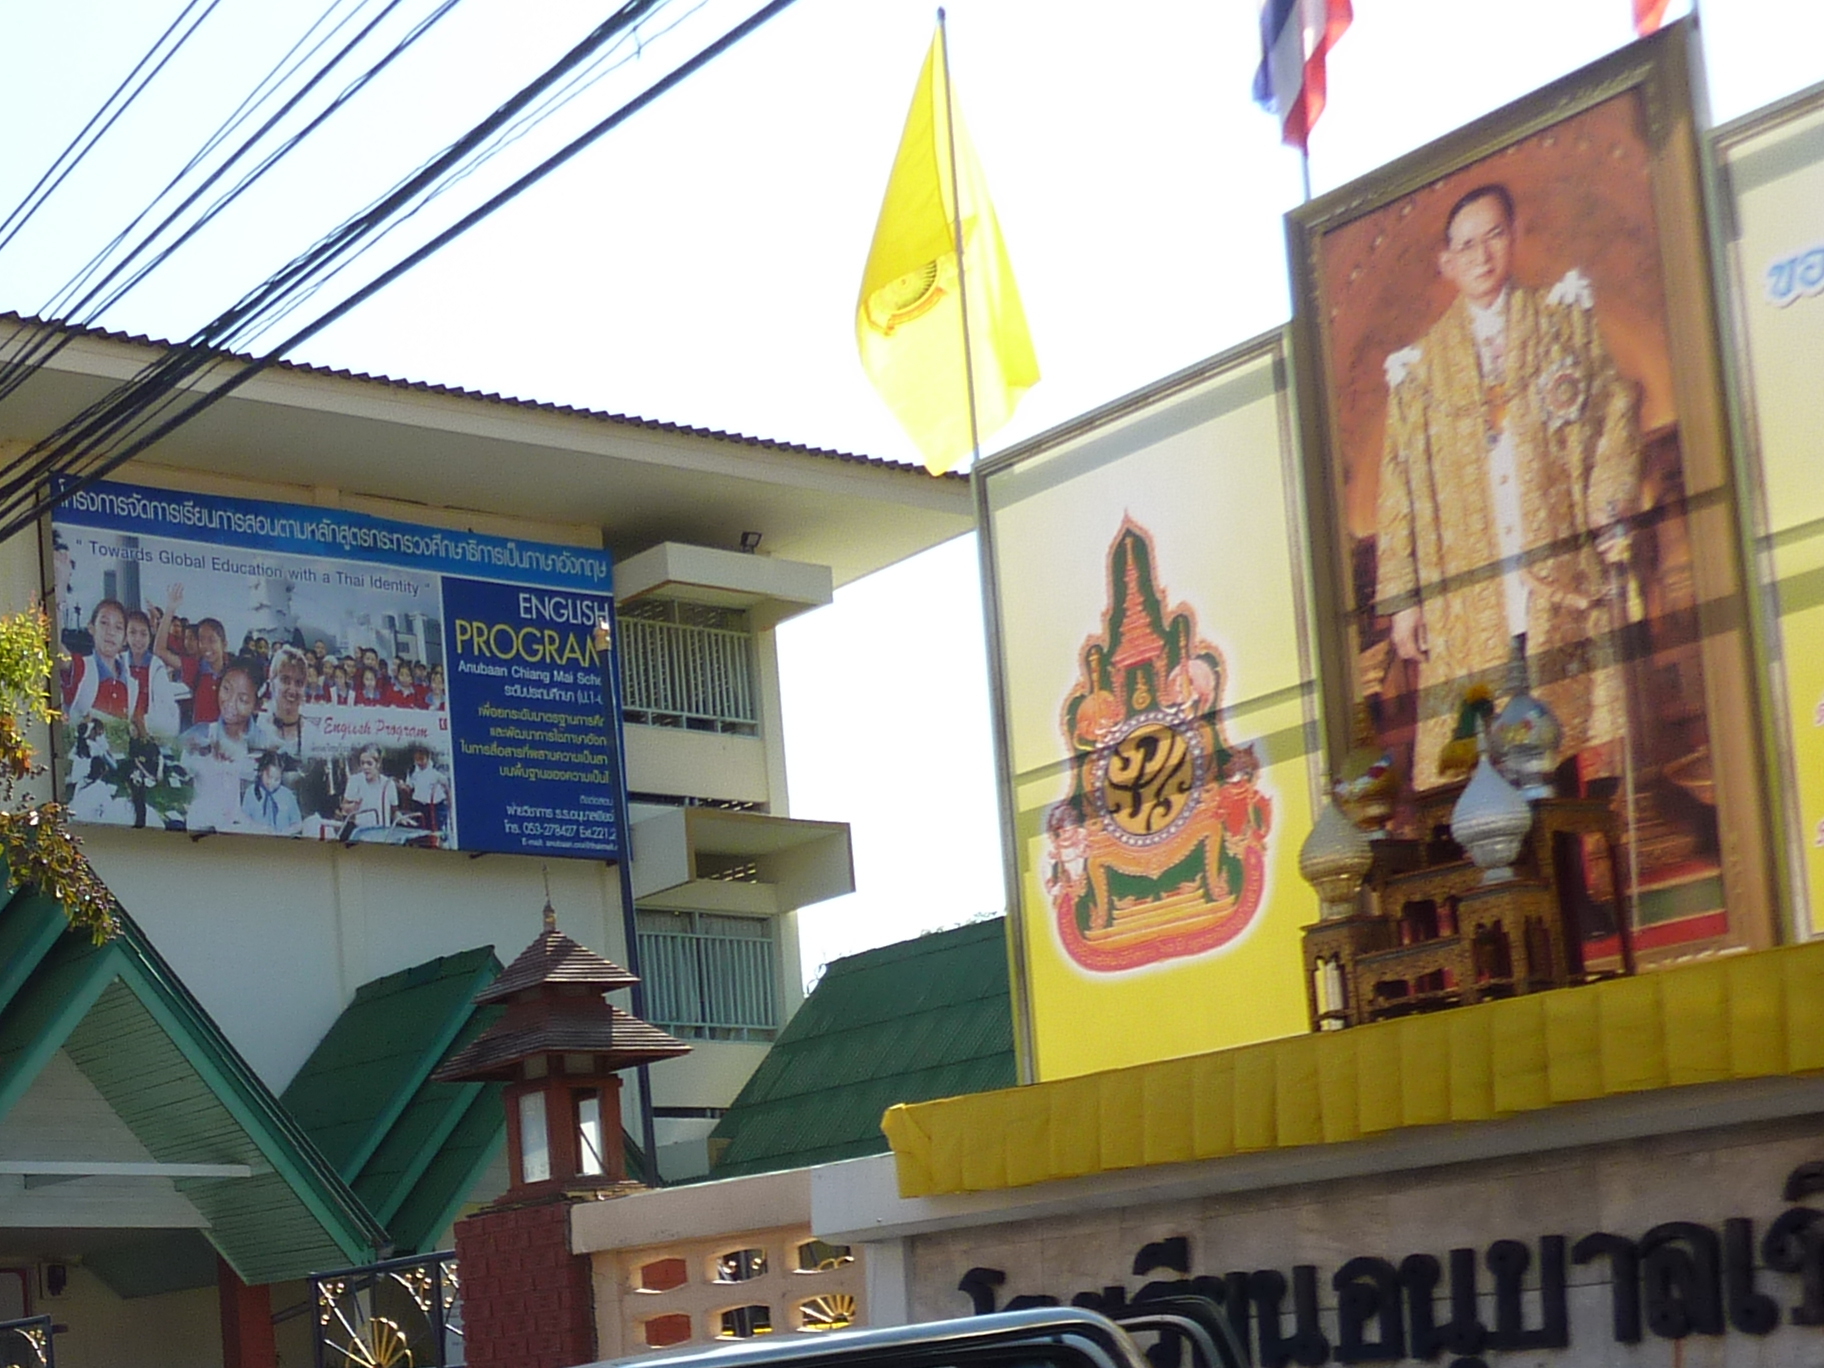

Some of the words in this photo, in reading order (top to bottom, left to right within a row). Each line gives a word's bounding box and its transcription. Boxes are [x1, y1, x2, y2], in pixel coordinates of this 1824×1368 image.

[89, 540, 153, 562] Towards
[159, 550, 206, 569] Global
[212, 557, 282, 579] Education
[288, 568, 317, 582] with
[322, 573, 330, 584] a
[336, 571, 365, 588] Thai
[370, 575, 419, 597] Identity
[519, 593, 609, 626] ENGLISH
[458, 660, 508, 677] Anubaan
[511, 666, 550, 684] Chiang
[553, 671, 574, 683] Mai
